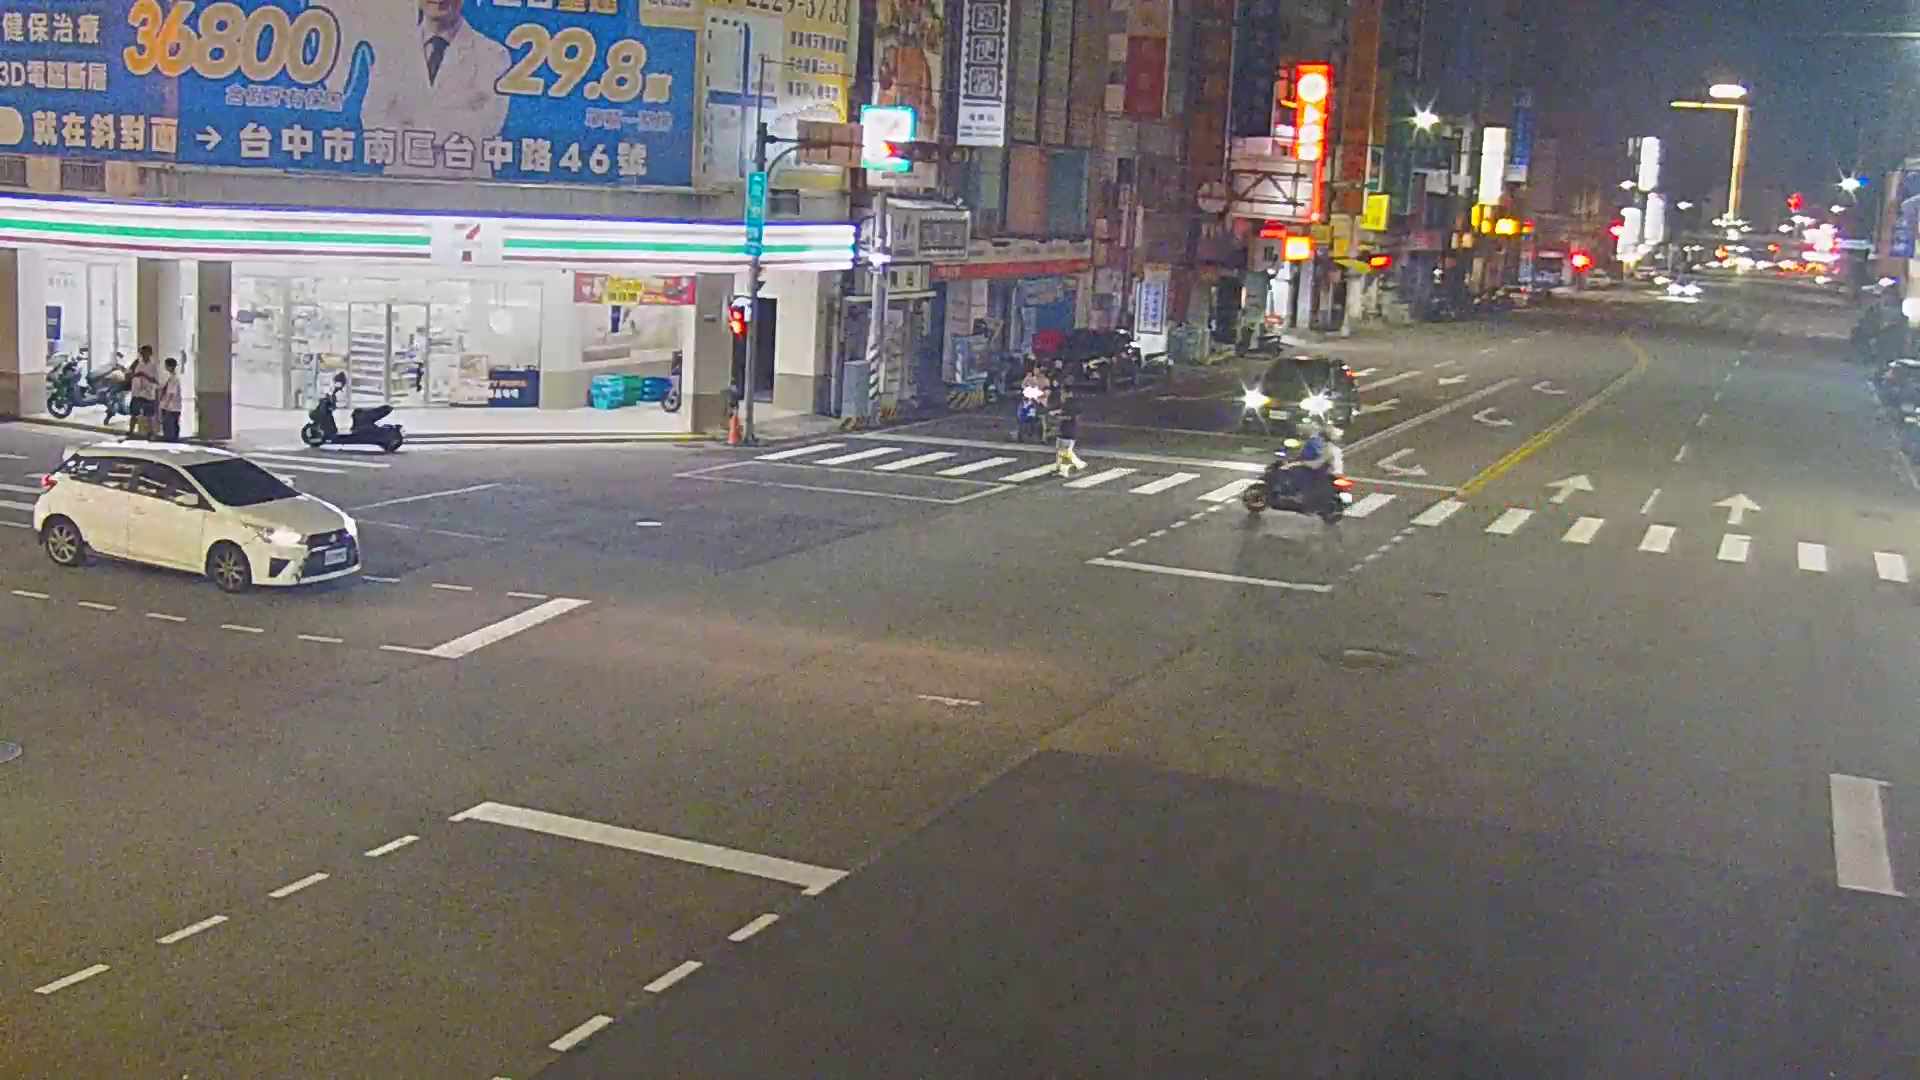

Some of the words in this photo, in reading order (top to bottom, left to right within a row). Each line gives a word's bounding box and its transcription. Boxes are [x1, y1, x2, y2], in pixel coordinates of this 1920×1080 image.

[123, 0, 339, 85] 36800
[495, 23, 673, 104] 29.8
[32, 110, 179, 154] 就在斜對面
[239, 122, 648, 177] 台中市南區台中路46號
